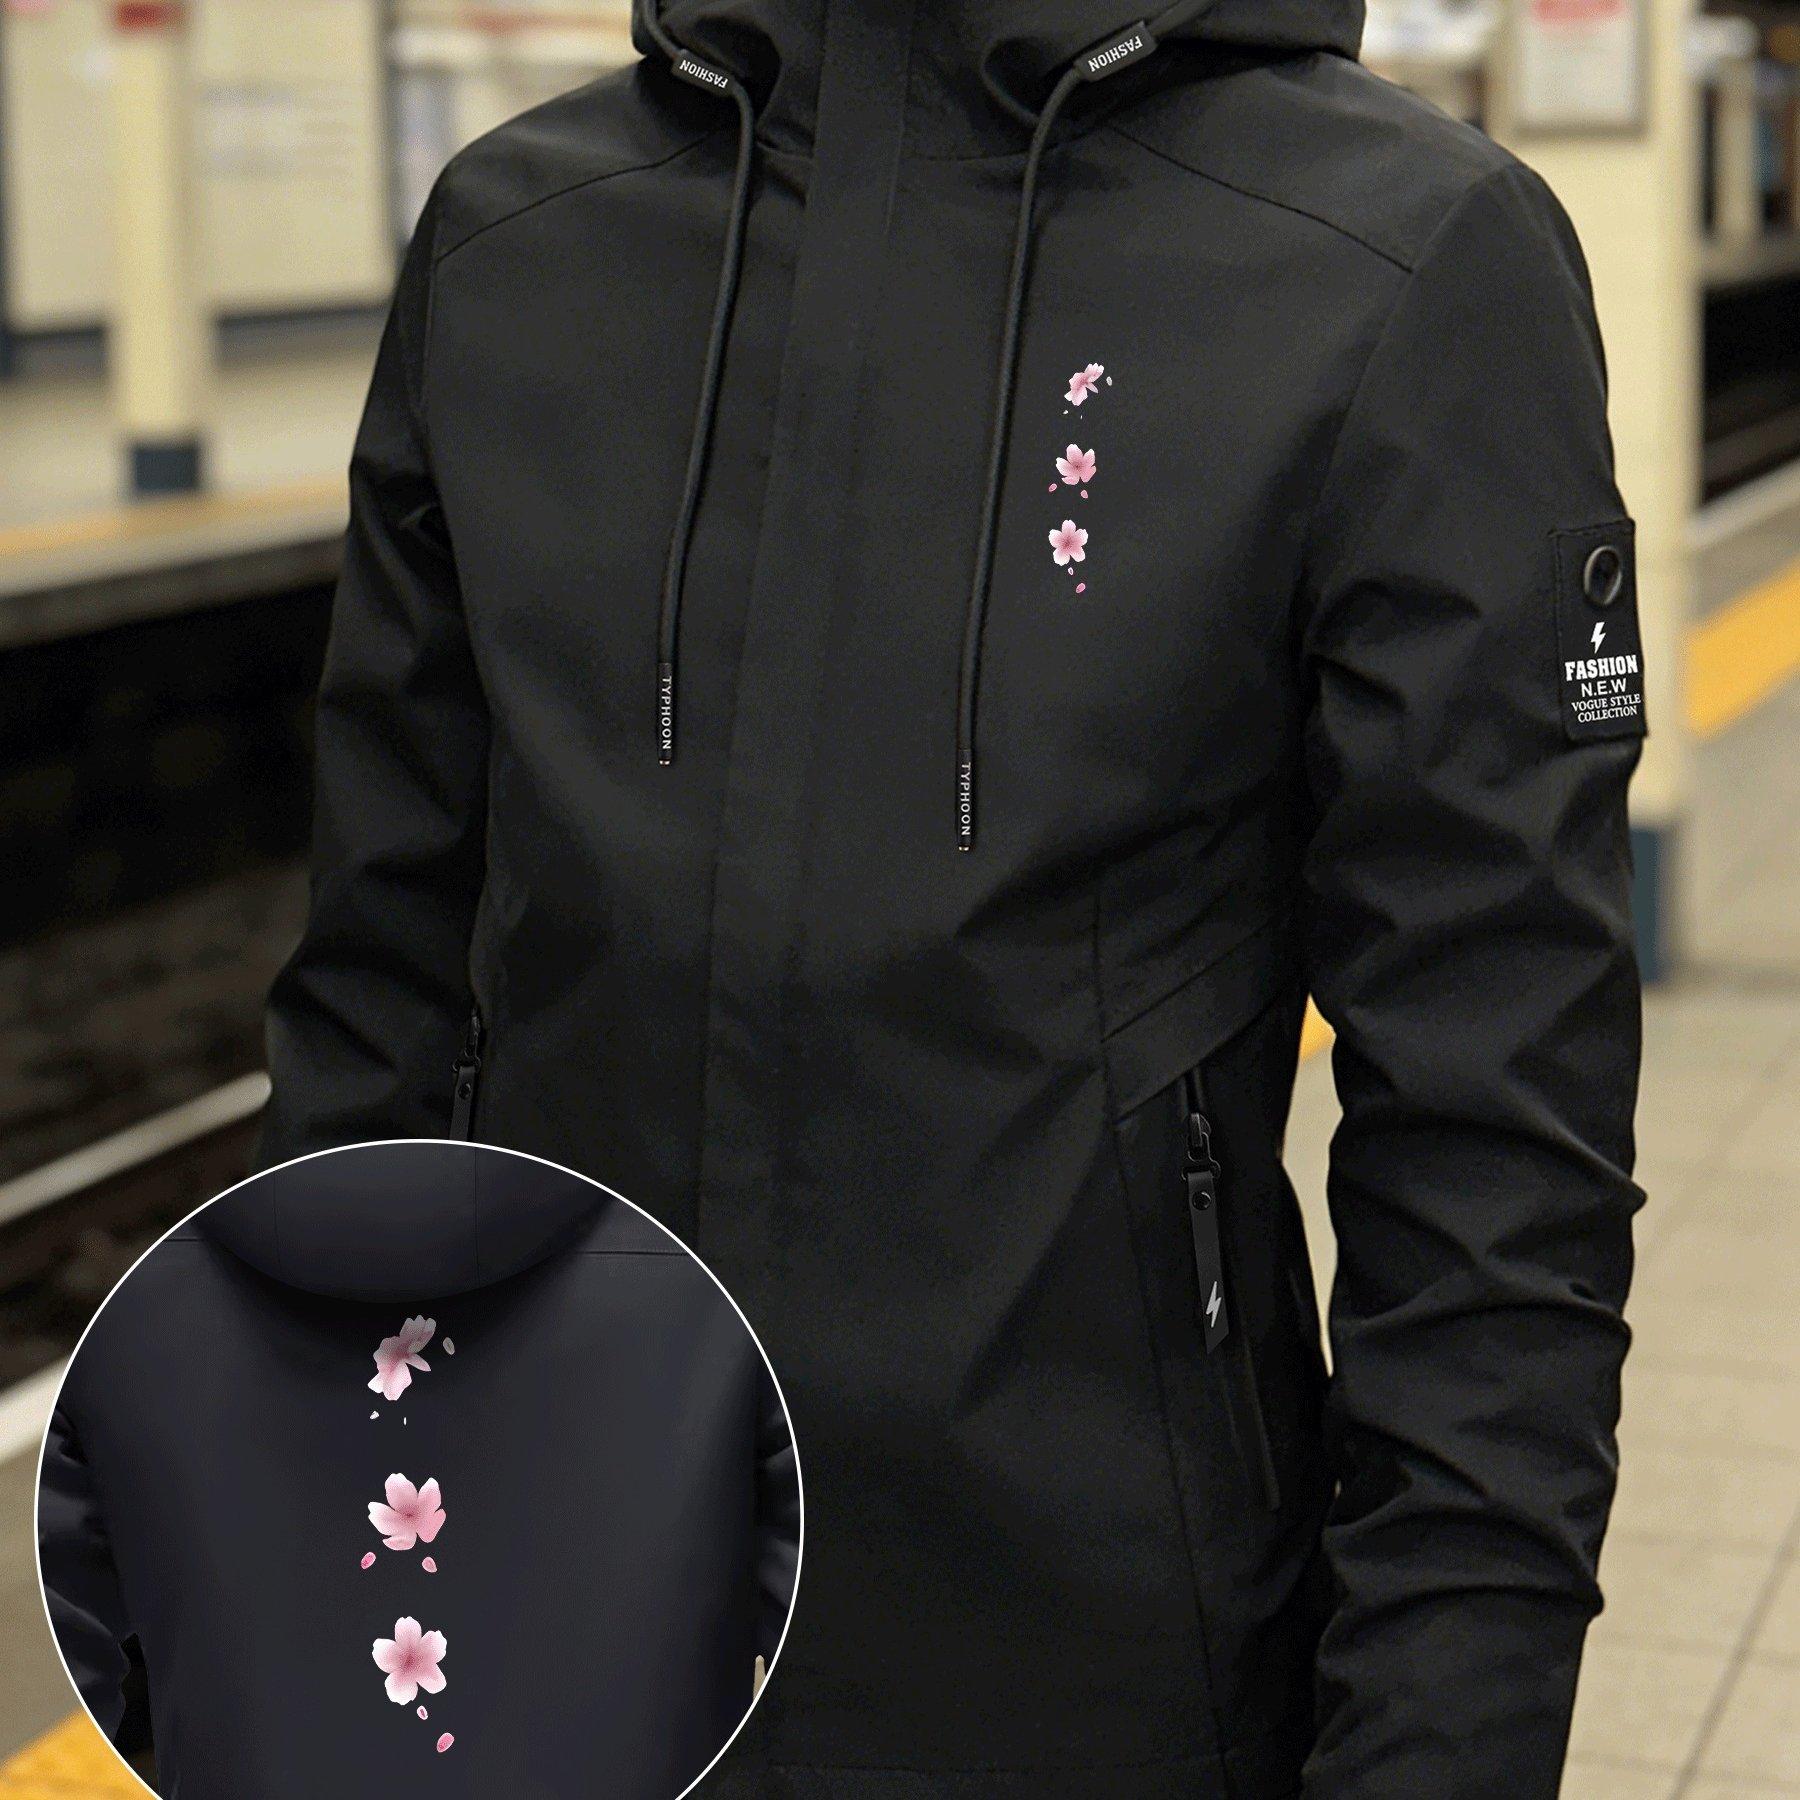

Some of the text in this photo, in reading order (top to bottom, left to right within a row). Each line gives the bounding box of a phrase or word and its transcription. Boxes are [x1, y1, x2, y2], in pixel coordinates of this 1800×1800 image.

[1088, 35, 1143, 72] FASHION
[679, 60, 729, 89] FASHION
[1564, 654, 1638, 681] FASHION
[1581, 678, 1627, 697] N.E.W
[661, 676, 672, 749] TYPHOON
[1571, 693, 1641, 712] VOGUE STYLE
[1577, 705, 1638, 723] COLLECTION
[960, 762, 971, 836] TYPHOON
